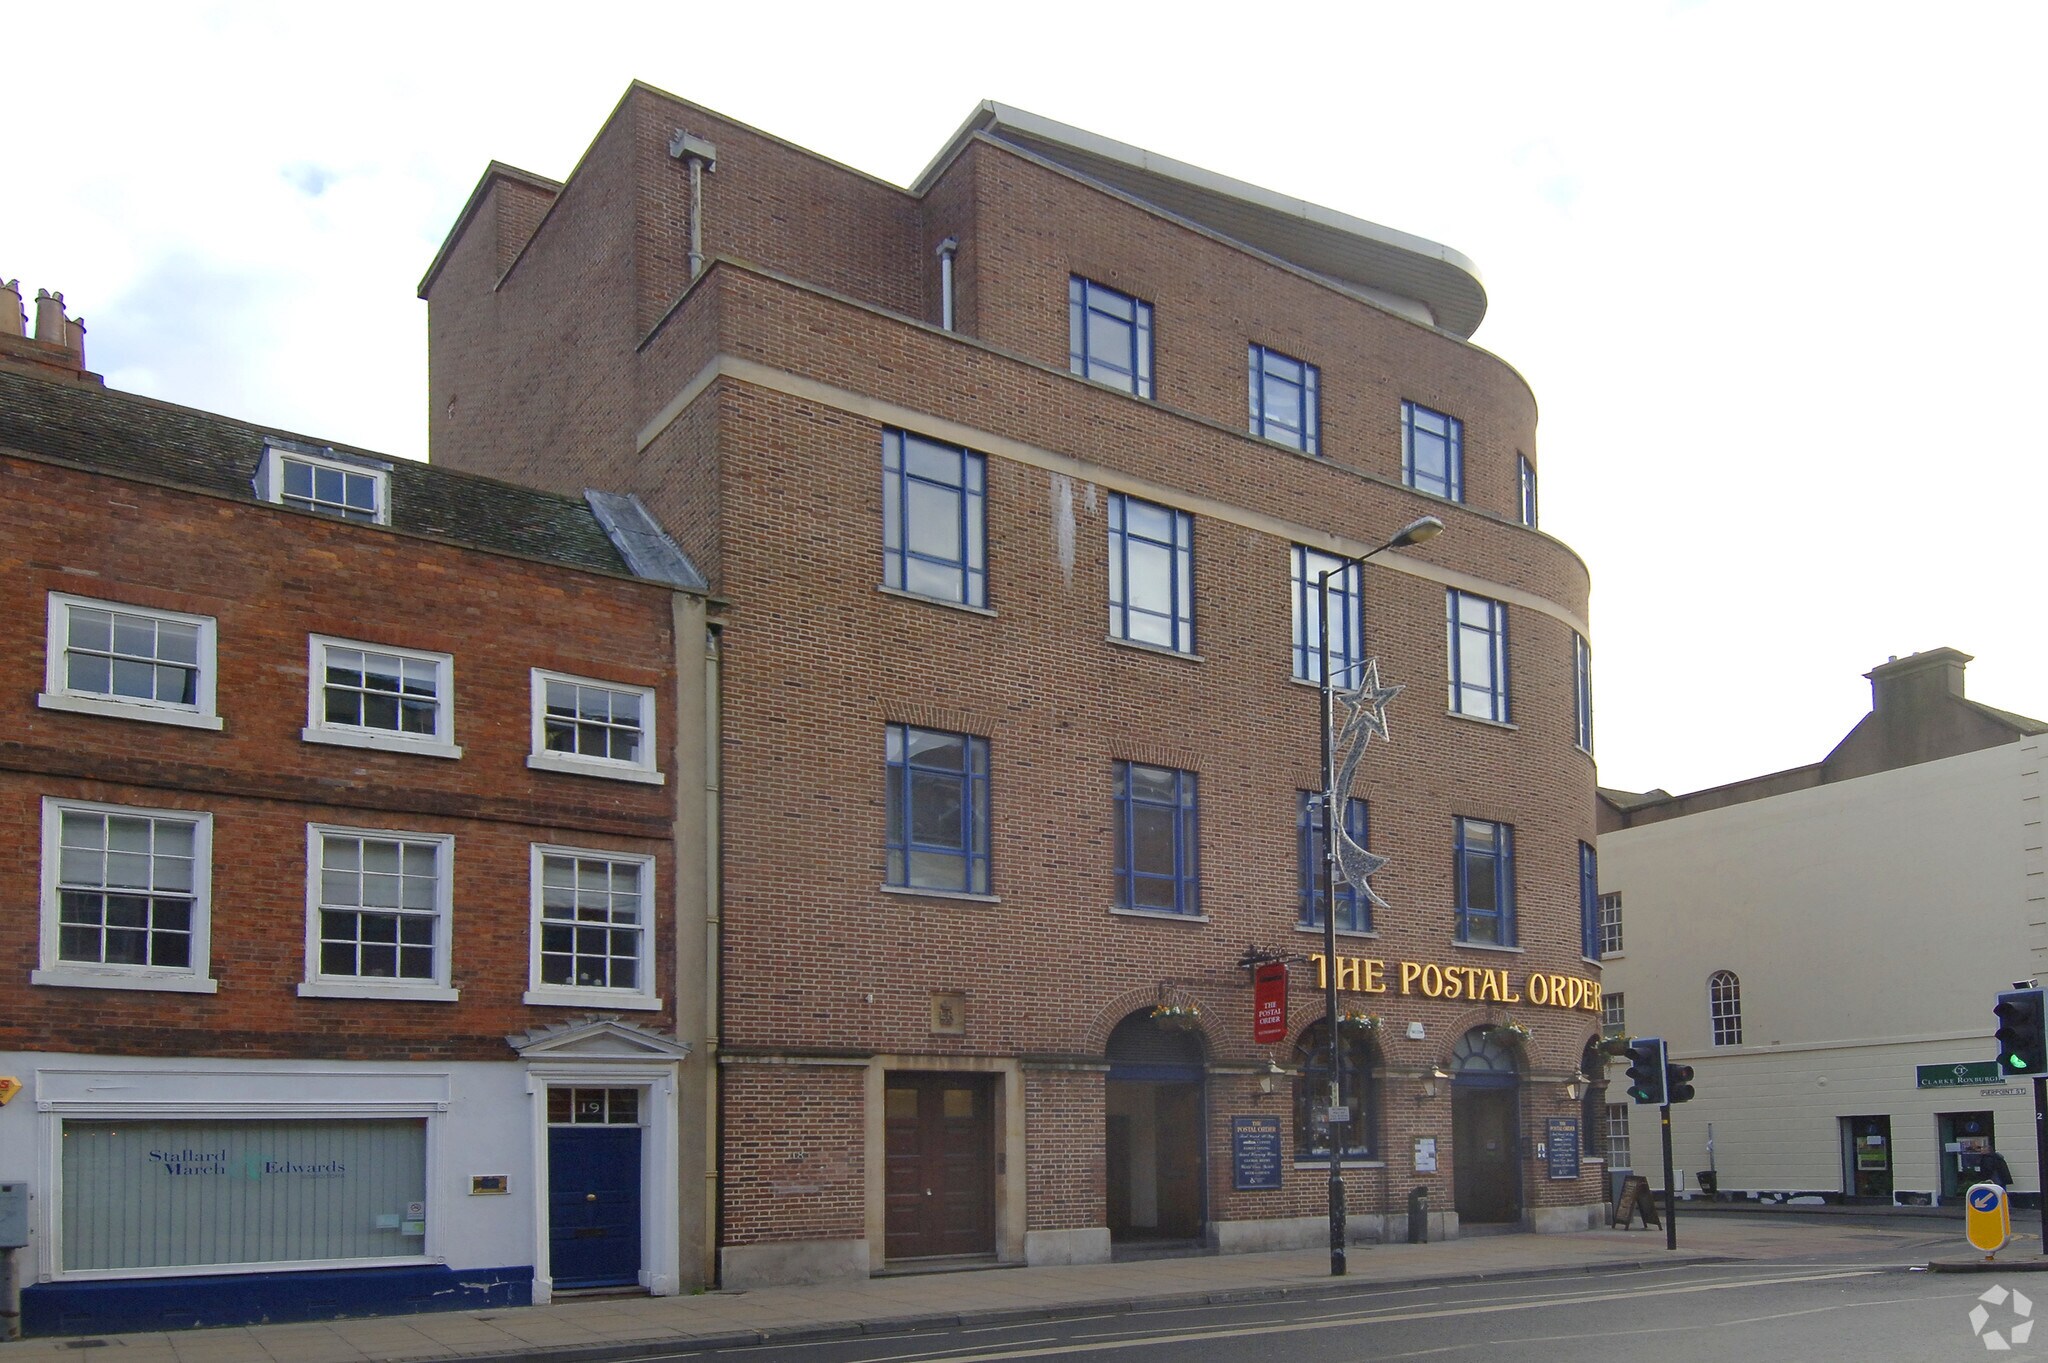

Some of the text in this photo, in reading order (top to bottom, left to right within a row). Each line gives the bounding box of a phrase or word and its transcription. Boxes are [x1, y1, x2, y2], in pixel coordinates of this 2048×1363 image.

[1311, 953, 1604, 1011] THE POSTAL ORDER
[1264, 1001, 1277, 1009] THE
[1259, 1008, 1281, 1017] POSTAL
[1260, 1016, 1281, 1024] ORDER
[582, 1103, 600, 1113] 19
[2036, 1112, 2043, 1120] 2
[149, 1149, 226, 1162] Stallard
[165, 1162, 225, 1175] March
[264, 1161, 345, 1173] Edwards
